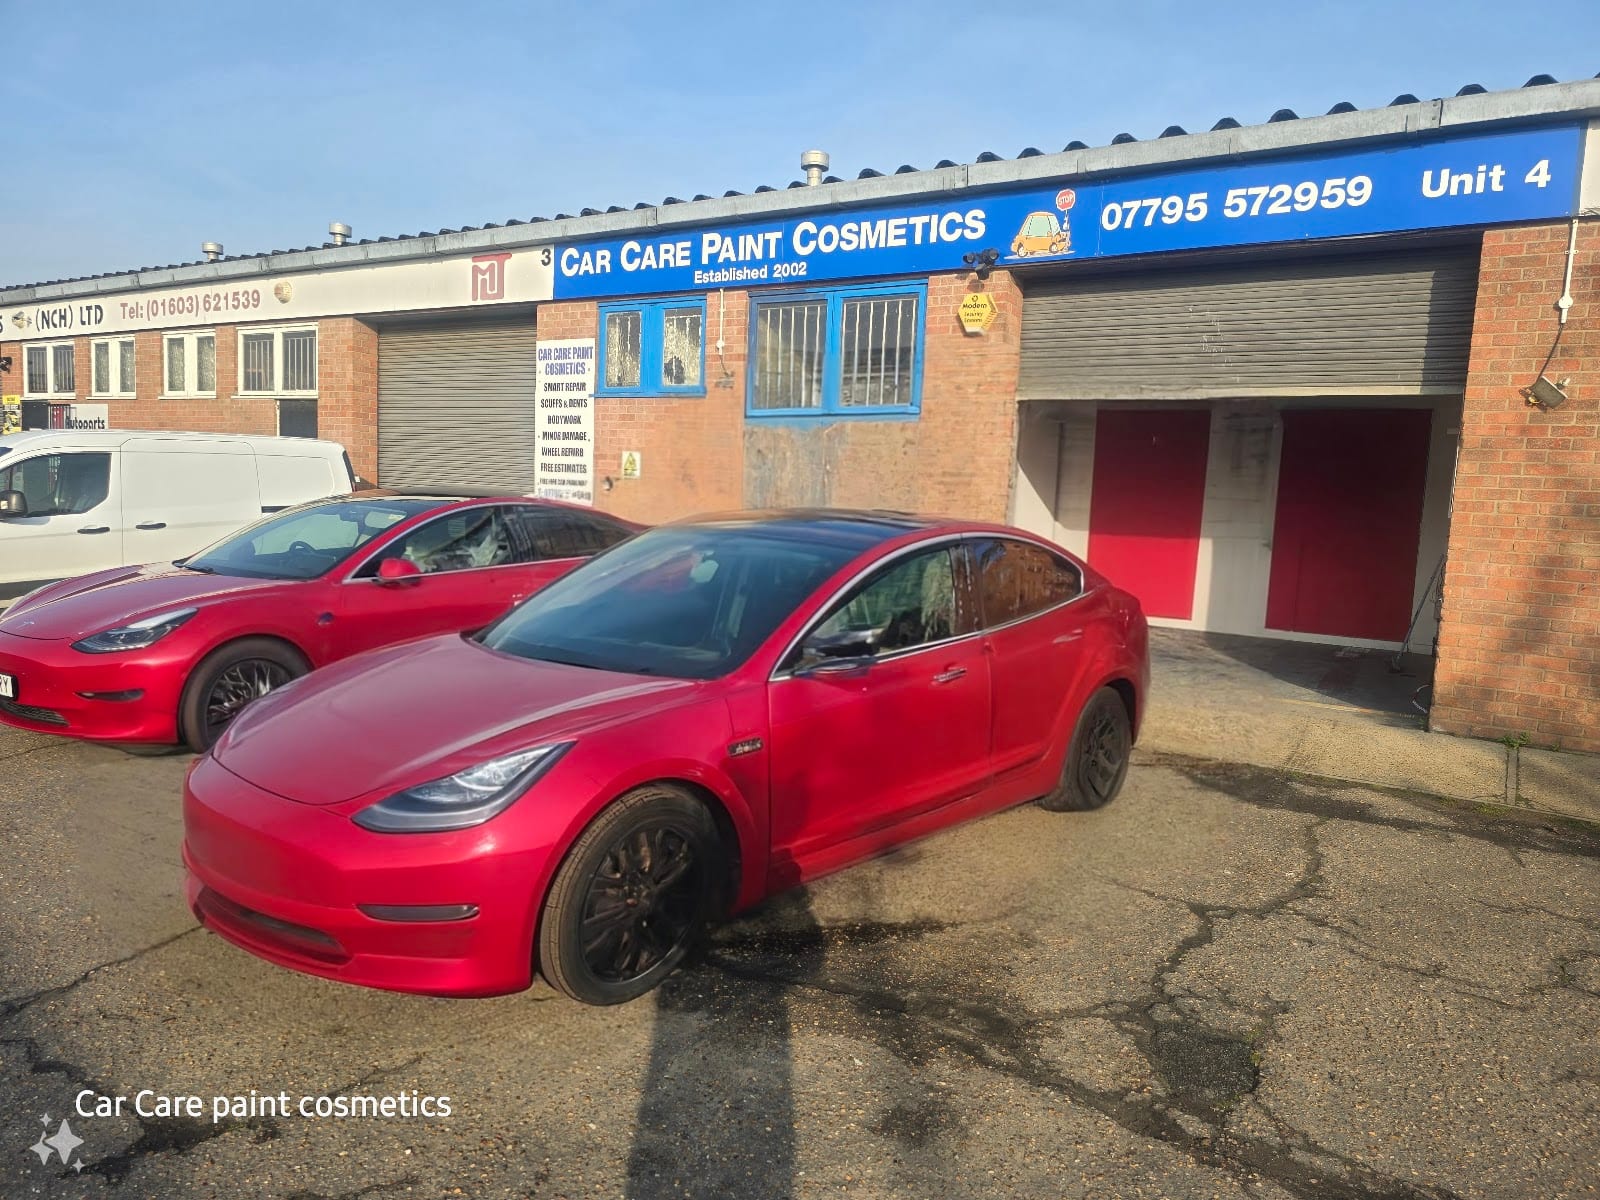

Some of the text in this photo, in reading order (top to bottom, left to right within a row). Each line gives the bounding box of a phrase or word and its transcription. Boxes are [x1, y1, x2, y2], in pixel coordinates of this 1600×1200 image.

[1421, 159, 1552, 199] Unit 4
[1058, 193, 1074, 206] STOP
[1100, 175, 1373, 232] 07795 572959
[560, 209, 987, 277] CAR CARE PAINT COSMETICS
[541, 248, 551, 266] 3
[694, 262, 807, 284] Established 2002
[119, 289, 261, 322] Tel: (01603) 621539
[35, 304, 104, 332] (NCH) LTD
[538, 346, 594, 361] CAR CARE PAINT
[545, 362, 586, 376] COSMETICS
[543, 382, 587, 392] SMART REPAIR
[540, 398, 563, 408] SCUFFS
[568, 398, 588, 408] DENTS
[547, 414, 582, 425] BODYWORK
[562, 431, 587, 441] DAMAGE
[541, 446, 560, 457] WHEEL
[540, 462, 587, 474] FREE ESTIMATES
